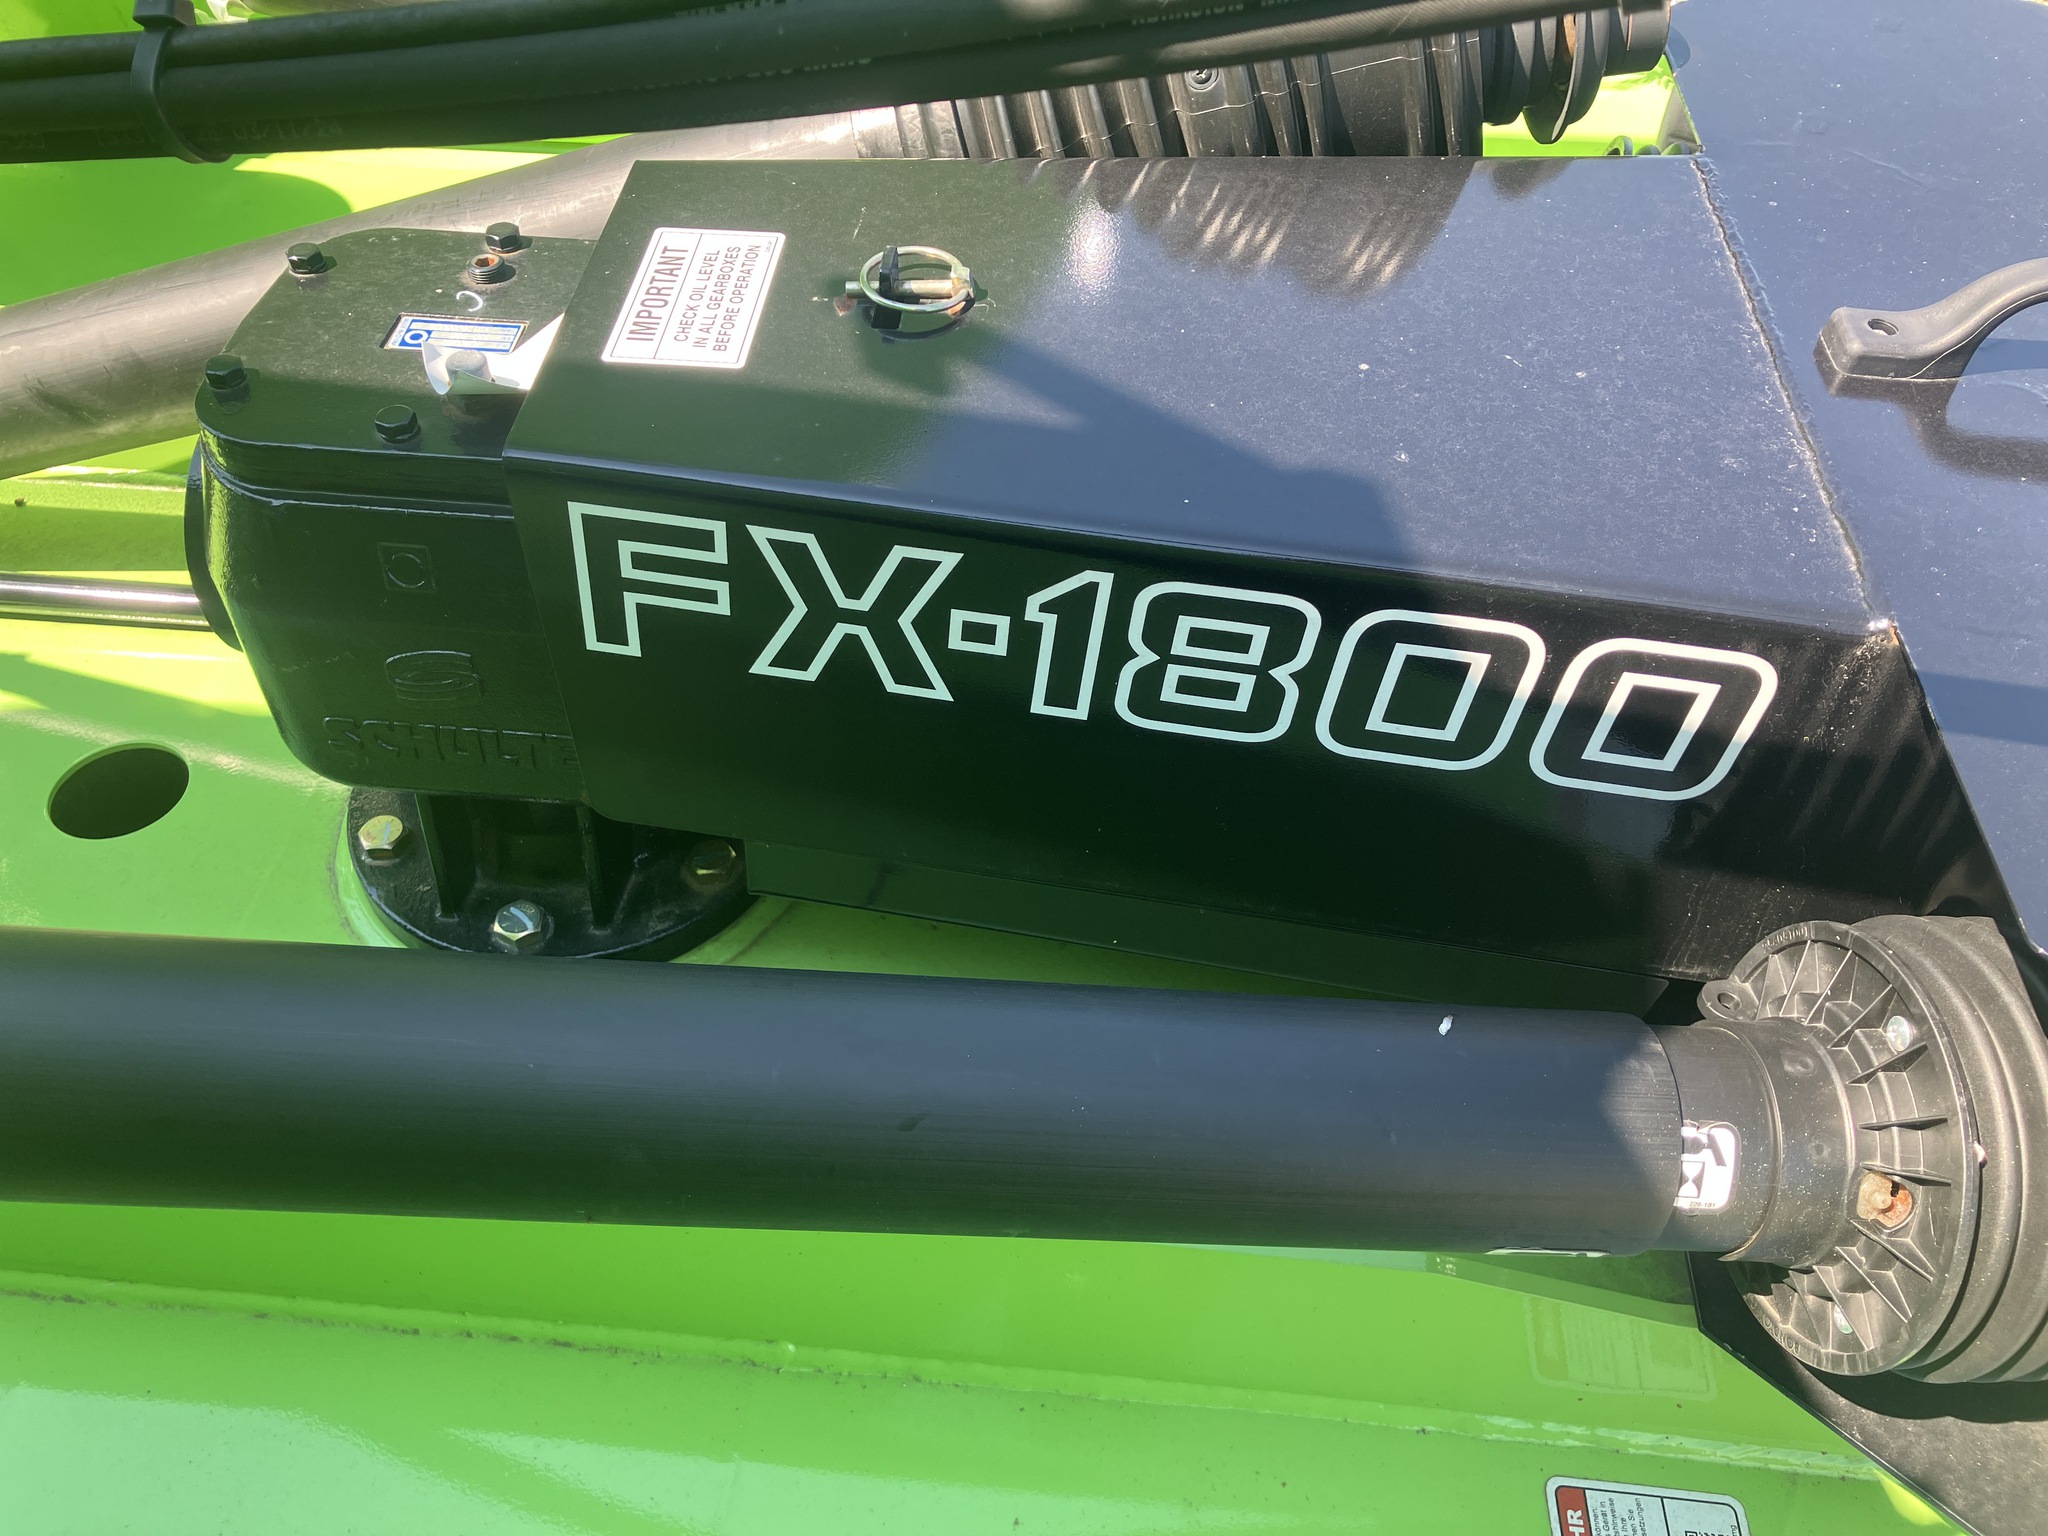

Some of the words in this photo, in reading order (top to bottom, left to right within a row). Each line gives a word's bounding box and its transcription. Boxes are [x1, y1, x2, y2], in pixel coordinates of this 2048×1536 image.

[696, 250, 720, 281] LEVEL
[706, 246, 741, 310] GEARBOXES
[626, 246, 689, 342] IMPORTANT
[689, 284, 708, 301] OIL
[712, 307, 741, 352] BEFORE
[729, 245, 762, 304] OPERATION
[674, 304, 701, 342] CHECK
[698, 313, 718, 334] ALL
[692, 337, 709, 348] IN
[567, 501, 1778, 801] FX-1800
[1627, 1508, 1635, 1521] Sie
